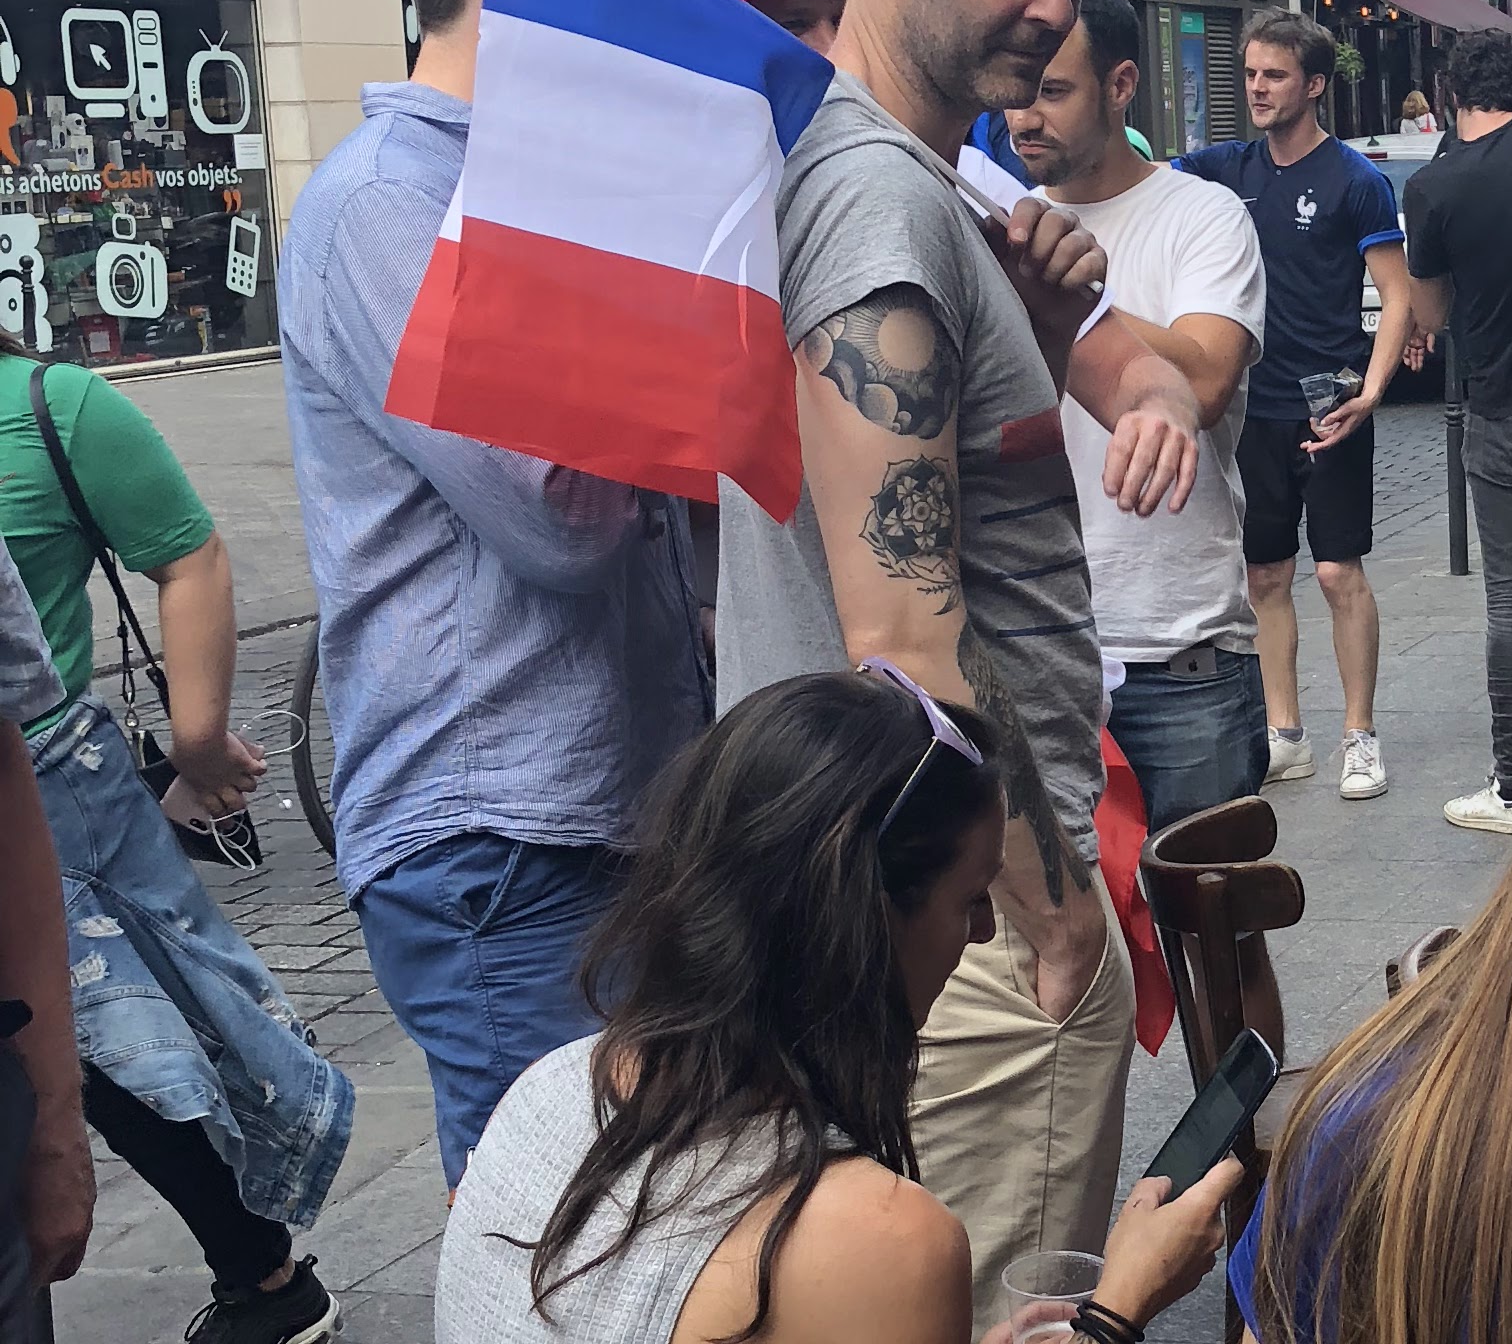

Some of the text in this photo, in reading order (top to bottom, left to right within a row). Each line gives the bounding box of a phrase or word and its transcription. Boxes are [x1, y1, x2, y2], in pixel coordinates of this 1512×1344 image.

[19, 169, 101, 194] achetons
[102, 163, 155, 189] Cash
[157, 172, 184, 188] vos
[188, 163, 243, 191] objets.
